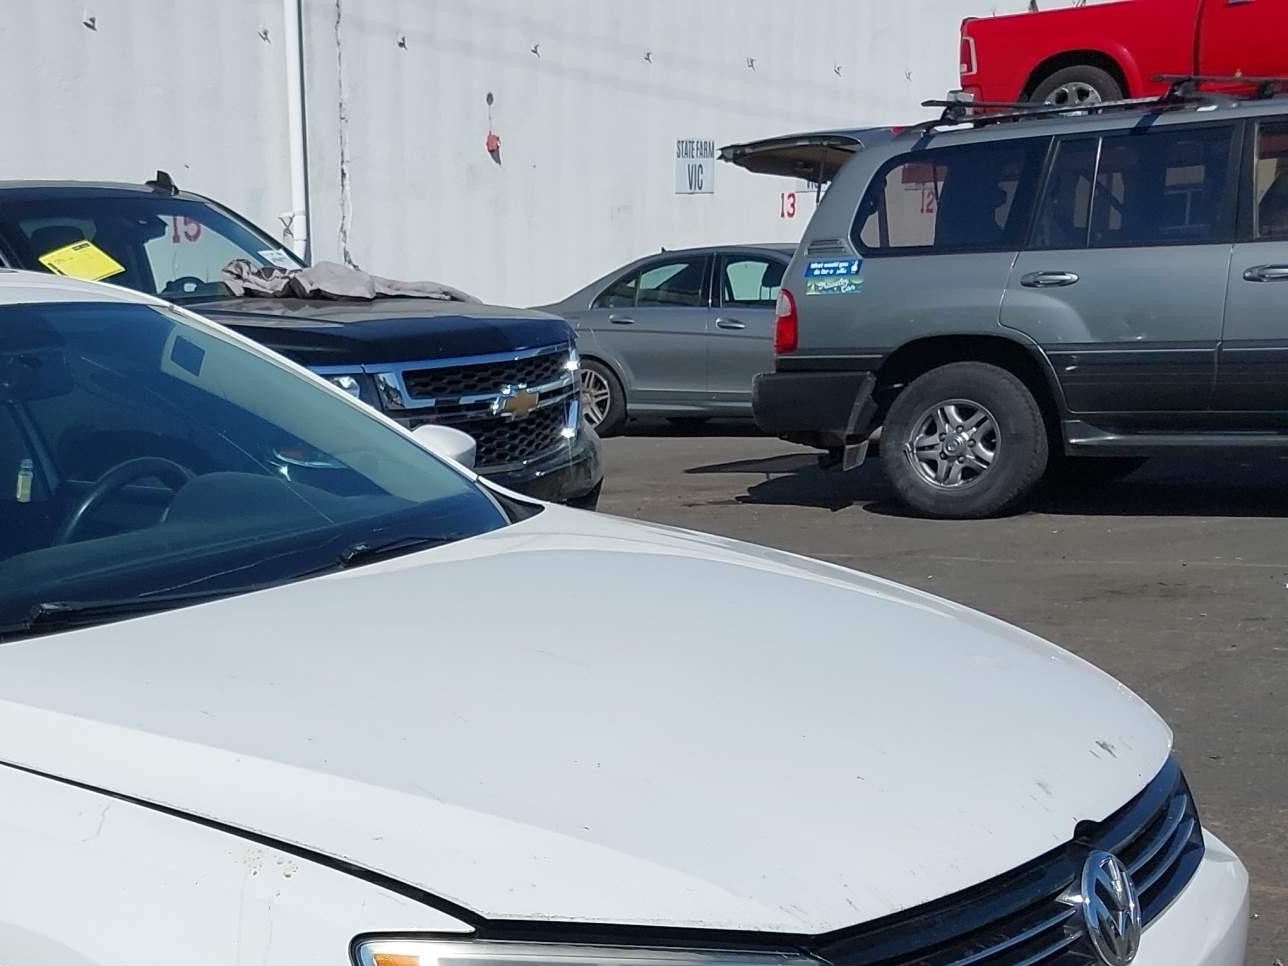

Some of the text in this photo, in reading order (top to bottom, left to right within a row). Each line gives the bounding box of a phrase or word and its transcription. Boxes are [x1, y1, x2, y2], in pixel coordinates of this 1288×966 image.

[677, 140, 714, 158] STATE FARM
[688, 164, 703, 190] VIC
[781, 193, 796, 218] 13
[920, 190, 935, 214] 12
[172, 216, 202, 243] 15
